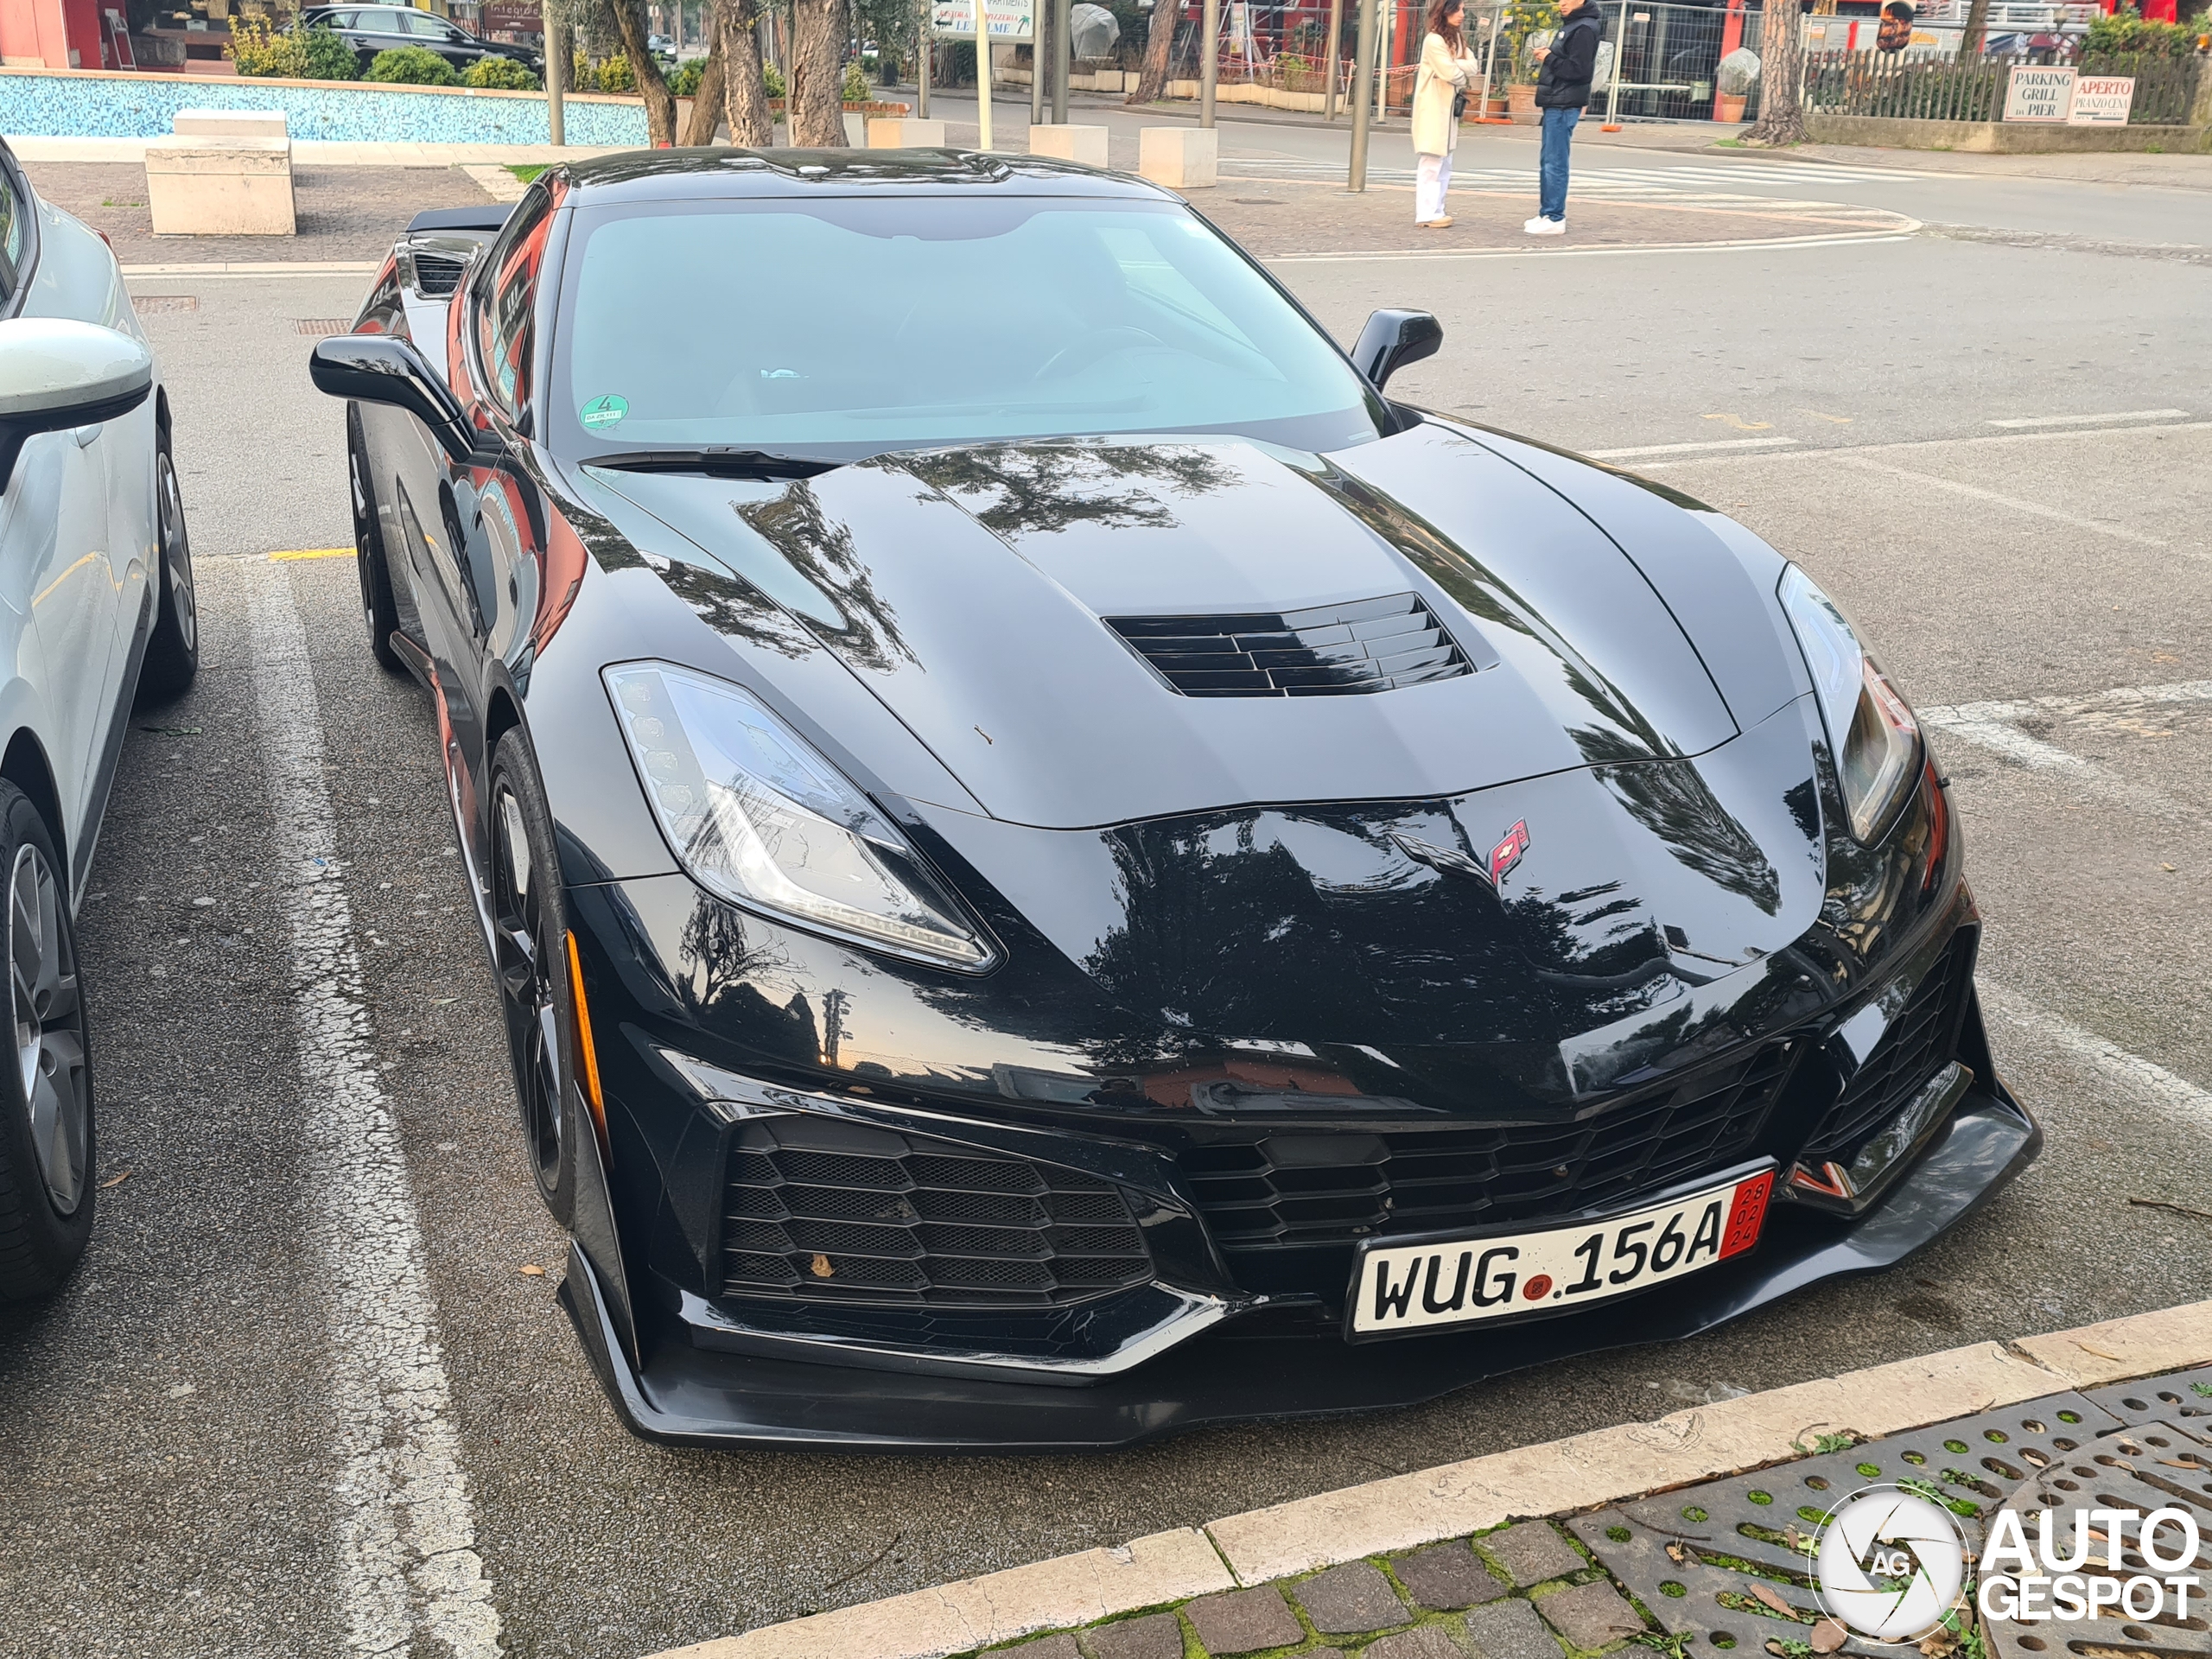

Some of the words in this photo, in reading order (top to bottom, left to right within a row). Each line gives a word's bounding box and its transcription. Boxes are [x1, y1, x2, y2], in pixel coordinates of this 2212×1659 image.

[956, 21, 969, 31] LE
[2015, 73, 2070, 86] PARKING
[2022, 88, 2058, 100] GRILL
[2078, 81, 2131, 94] APERTO
[2028, 104, 2056, 116] PIER
[2075, 98, 2107, 108] PRANZO
[2108, 98, 2127, 109] CENA
[1741, 1183, 1765, 1205] 28
[1736, 1205, 1758, 1225] 02
[1730, 1224, 1751, 1247] 24
